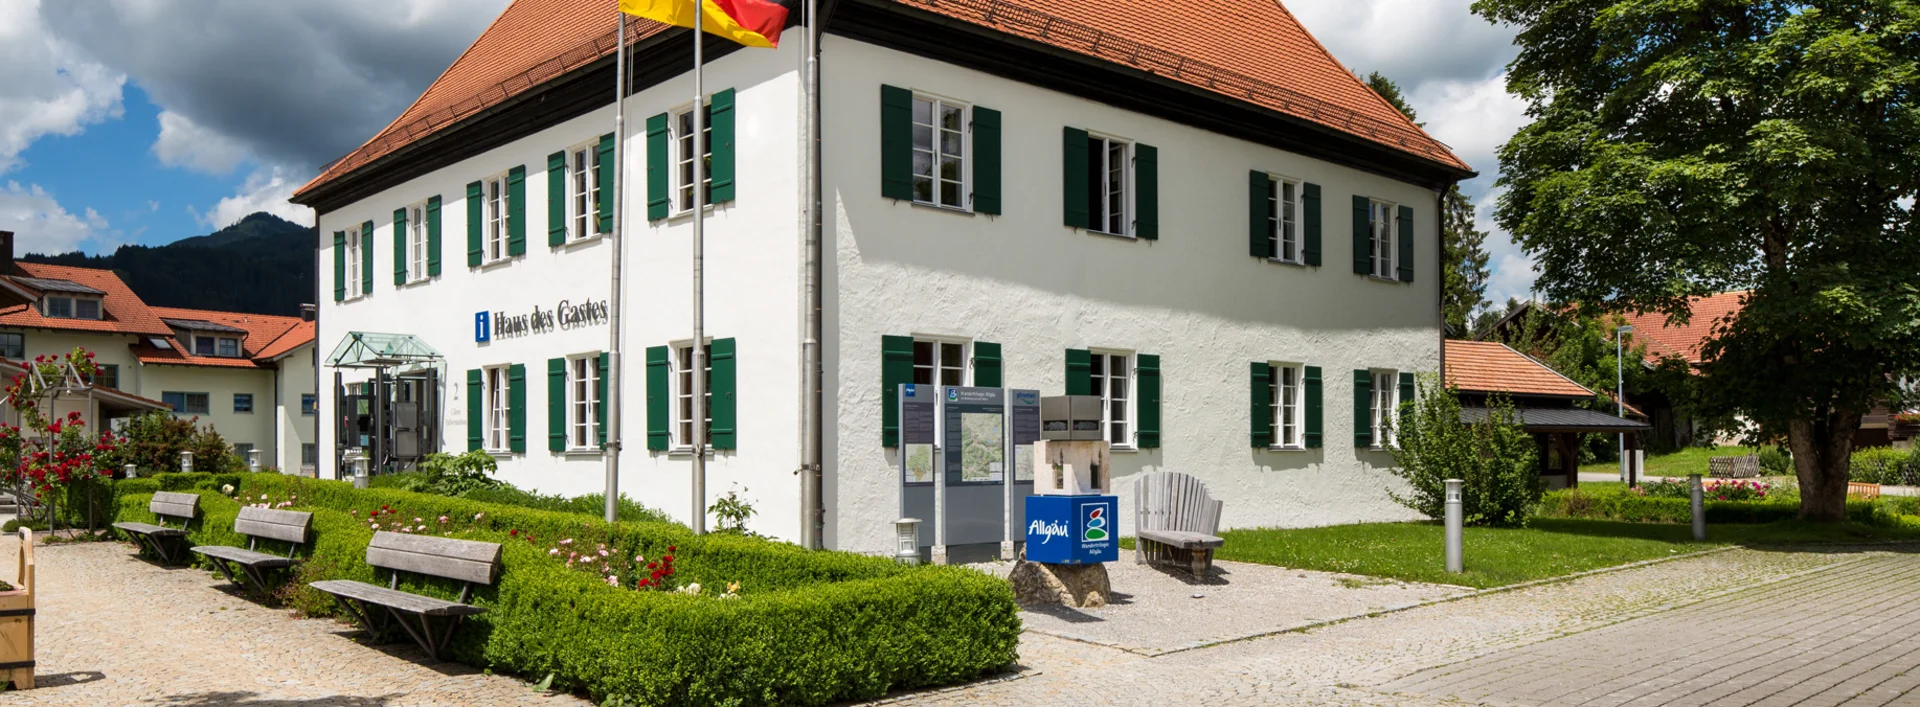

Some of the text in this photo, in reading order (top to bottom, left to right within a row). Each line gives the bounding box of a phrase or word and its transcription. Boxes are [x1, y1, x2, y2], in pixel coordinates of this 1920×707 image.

[493, 311, 527, 336] Haus
[530, 304, 554, 331] des
[557, 297, 608, 326] Gastes
[453, 382, 459, 400] 2
[1028, 519, 1069, 545] Allgäu
